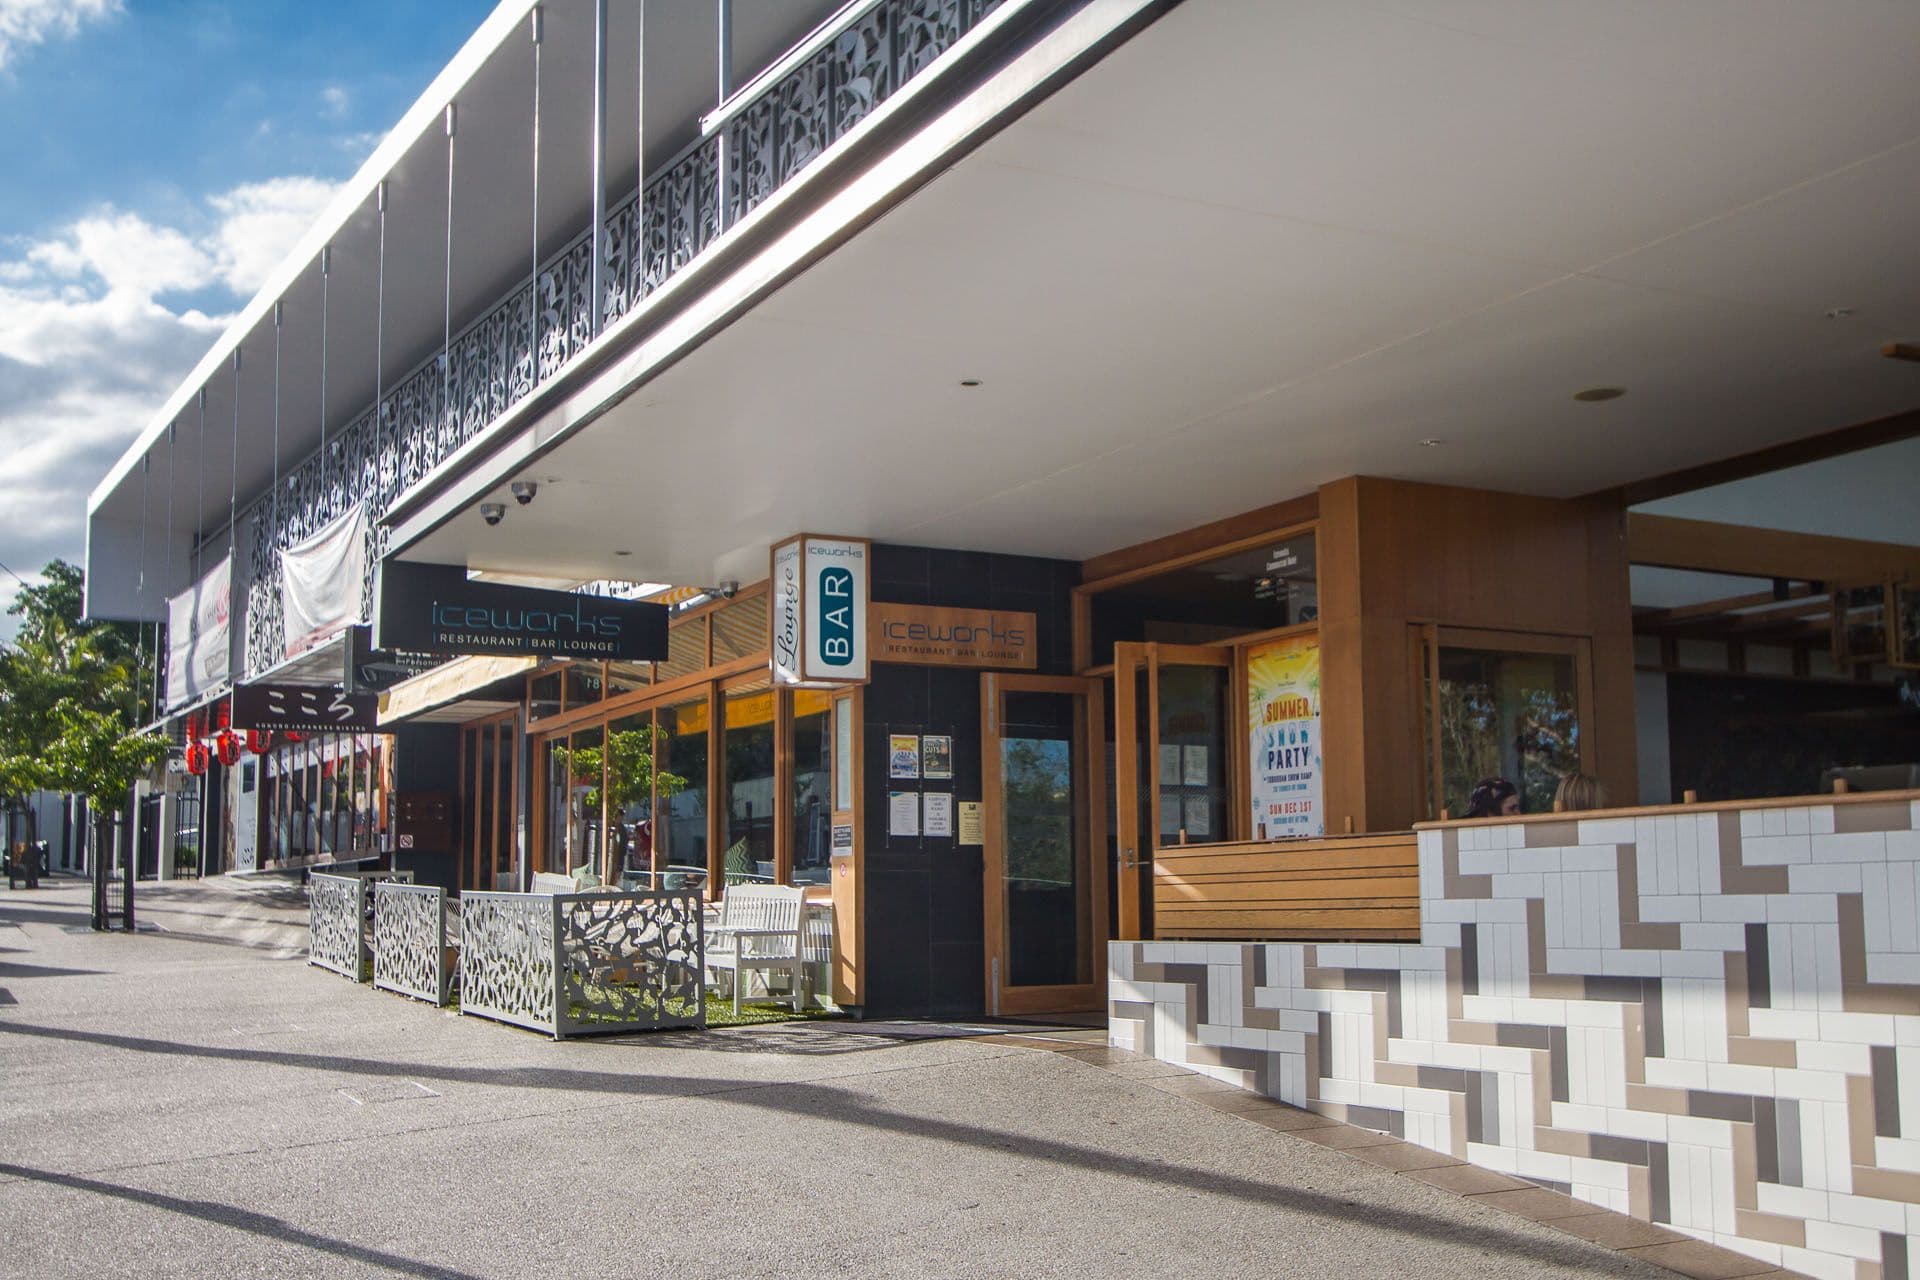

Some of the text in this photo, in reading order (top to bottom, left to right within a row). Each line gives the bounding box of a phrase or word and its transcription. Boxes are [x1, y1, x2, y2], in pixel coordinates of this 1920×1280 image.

[808, 544, 863, 558] iceworks
[432, 599, 624, 636] iceworks
[777, 567, 799, 672] Lounge
[825, 575, 849, 658] BAR
[440, 633, 615, 651] RESTAURANT BAR LOUNGE
[882, 616, 1025, 648] iceworks
[1266, 696, 1309, 722] SUMMER
[1268, 723, 1309, 748] SNOW
[1268, 746, 1309, 770] PARTY
[1269, 801, 1312, 815] SUN DEC 1ST
